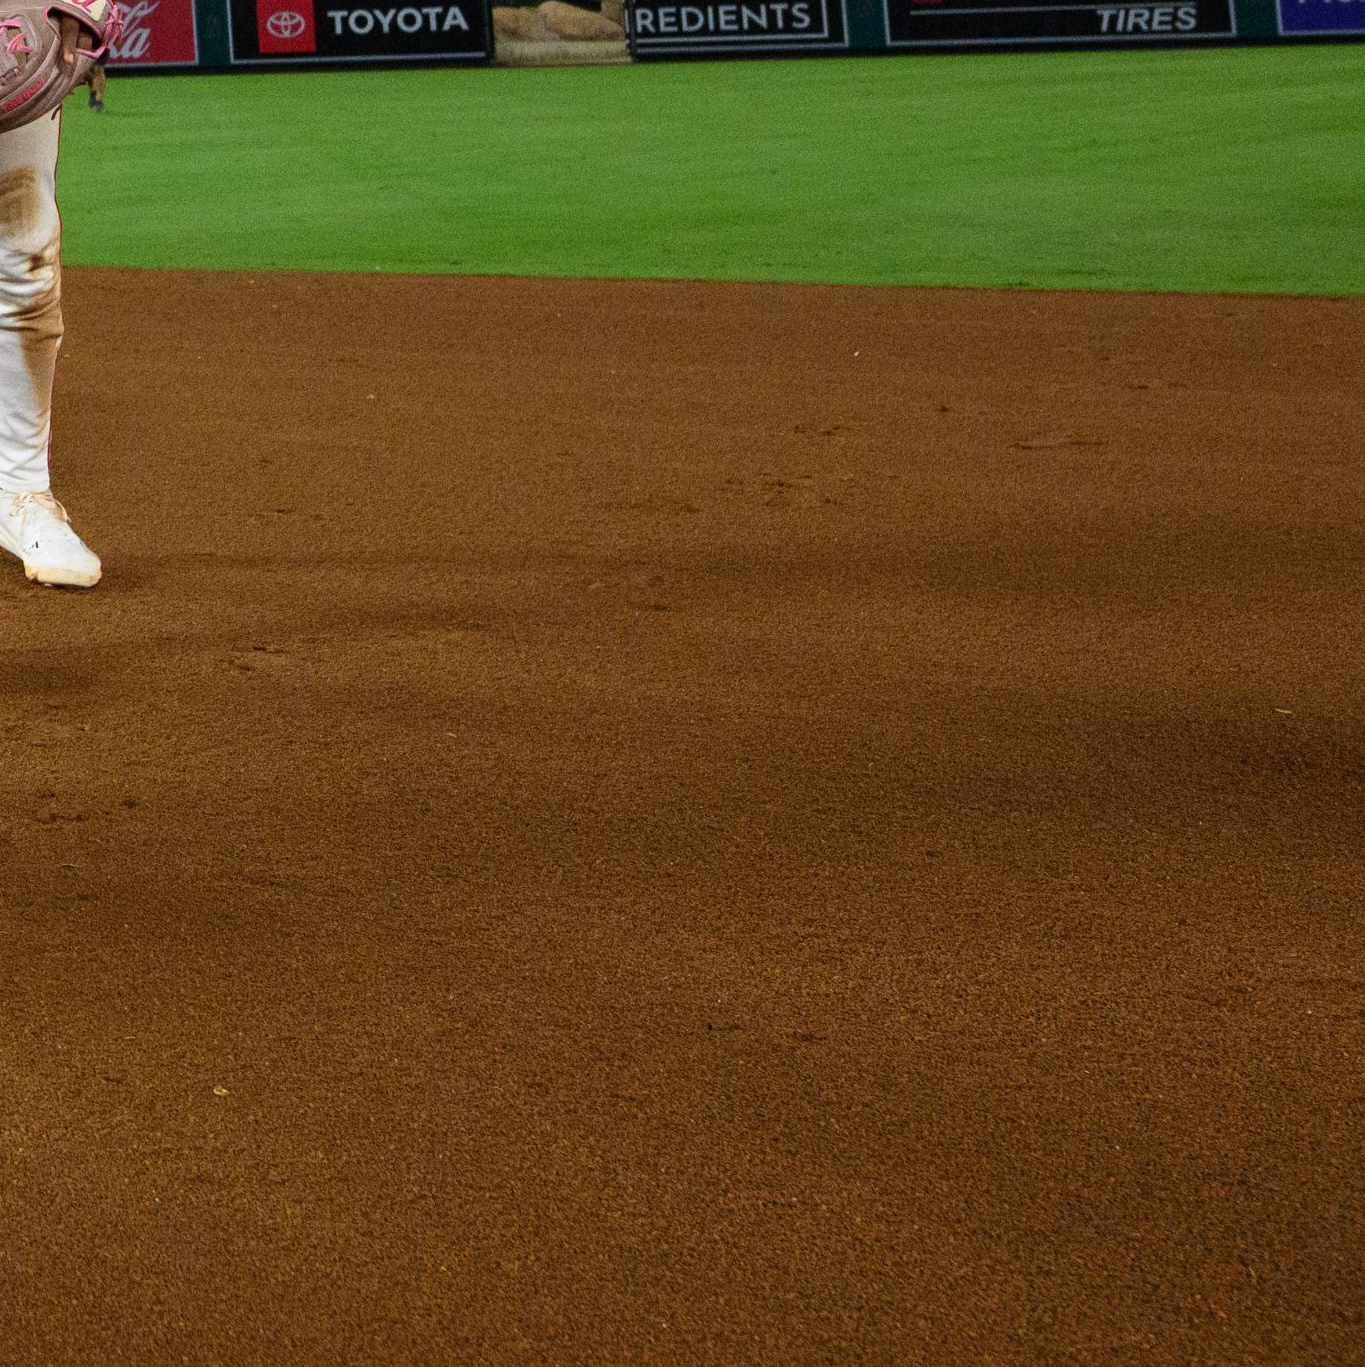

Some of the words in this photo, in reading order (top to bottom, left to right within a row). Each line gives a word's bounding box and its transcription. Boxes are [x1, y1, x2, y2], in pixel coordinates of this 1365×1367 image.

[327, 6, 469, 36] TOYOTA
[635, 2, 811, 34] REDIENTS
[1098, 6, 1197, 33] TIRES
